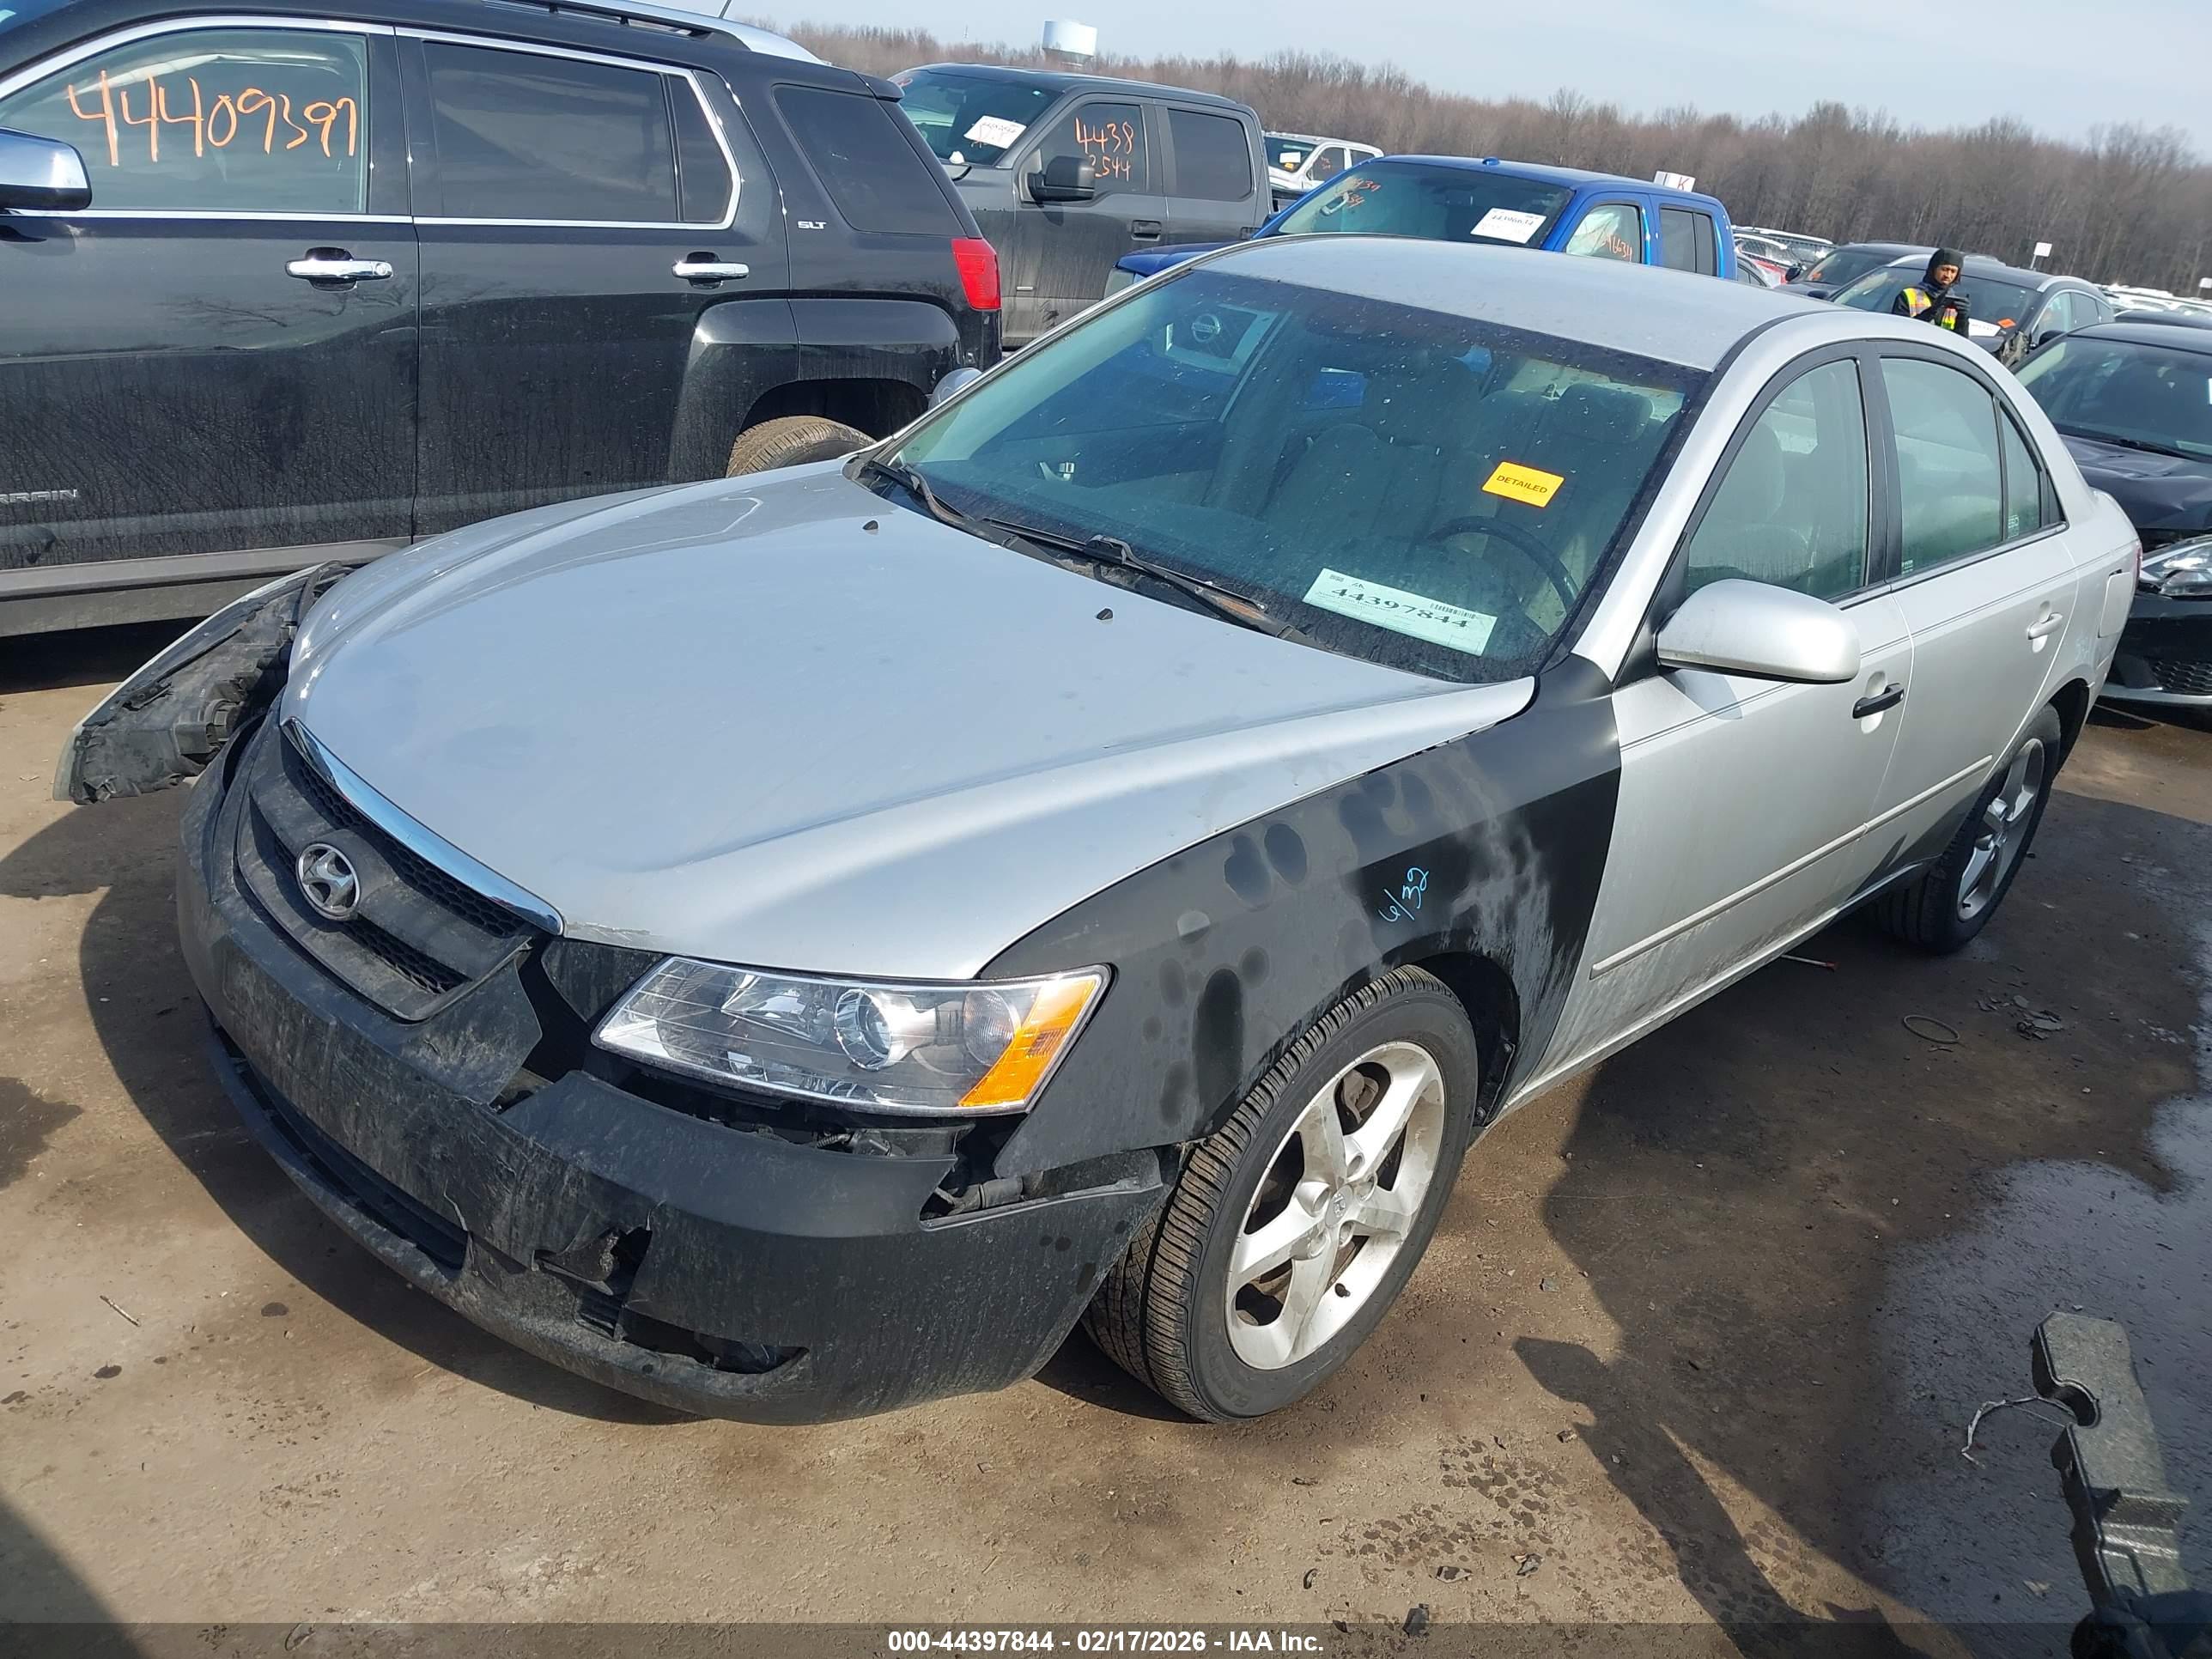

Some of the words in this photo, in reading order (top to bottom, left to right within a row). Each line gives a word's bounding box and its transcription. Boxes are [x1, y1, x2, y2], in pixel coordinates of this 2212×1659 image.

[69, 70, 357, 167] 44409397
[1075, 117, 1134, 155] 4438
[797, 221, 827, 229] SLT
[1496, 475, 1548, 494] DETAILED
[1331, 588, 1469, 628] 44397844
[1377, 866, 1430, 922] 6/32
